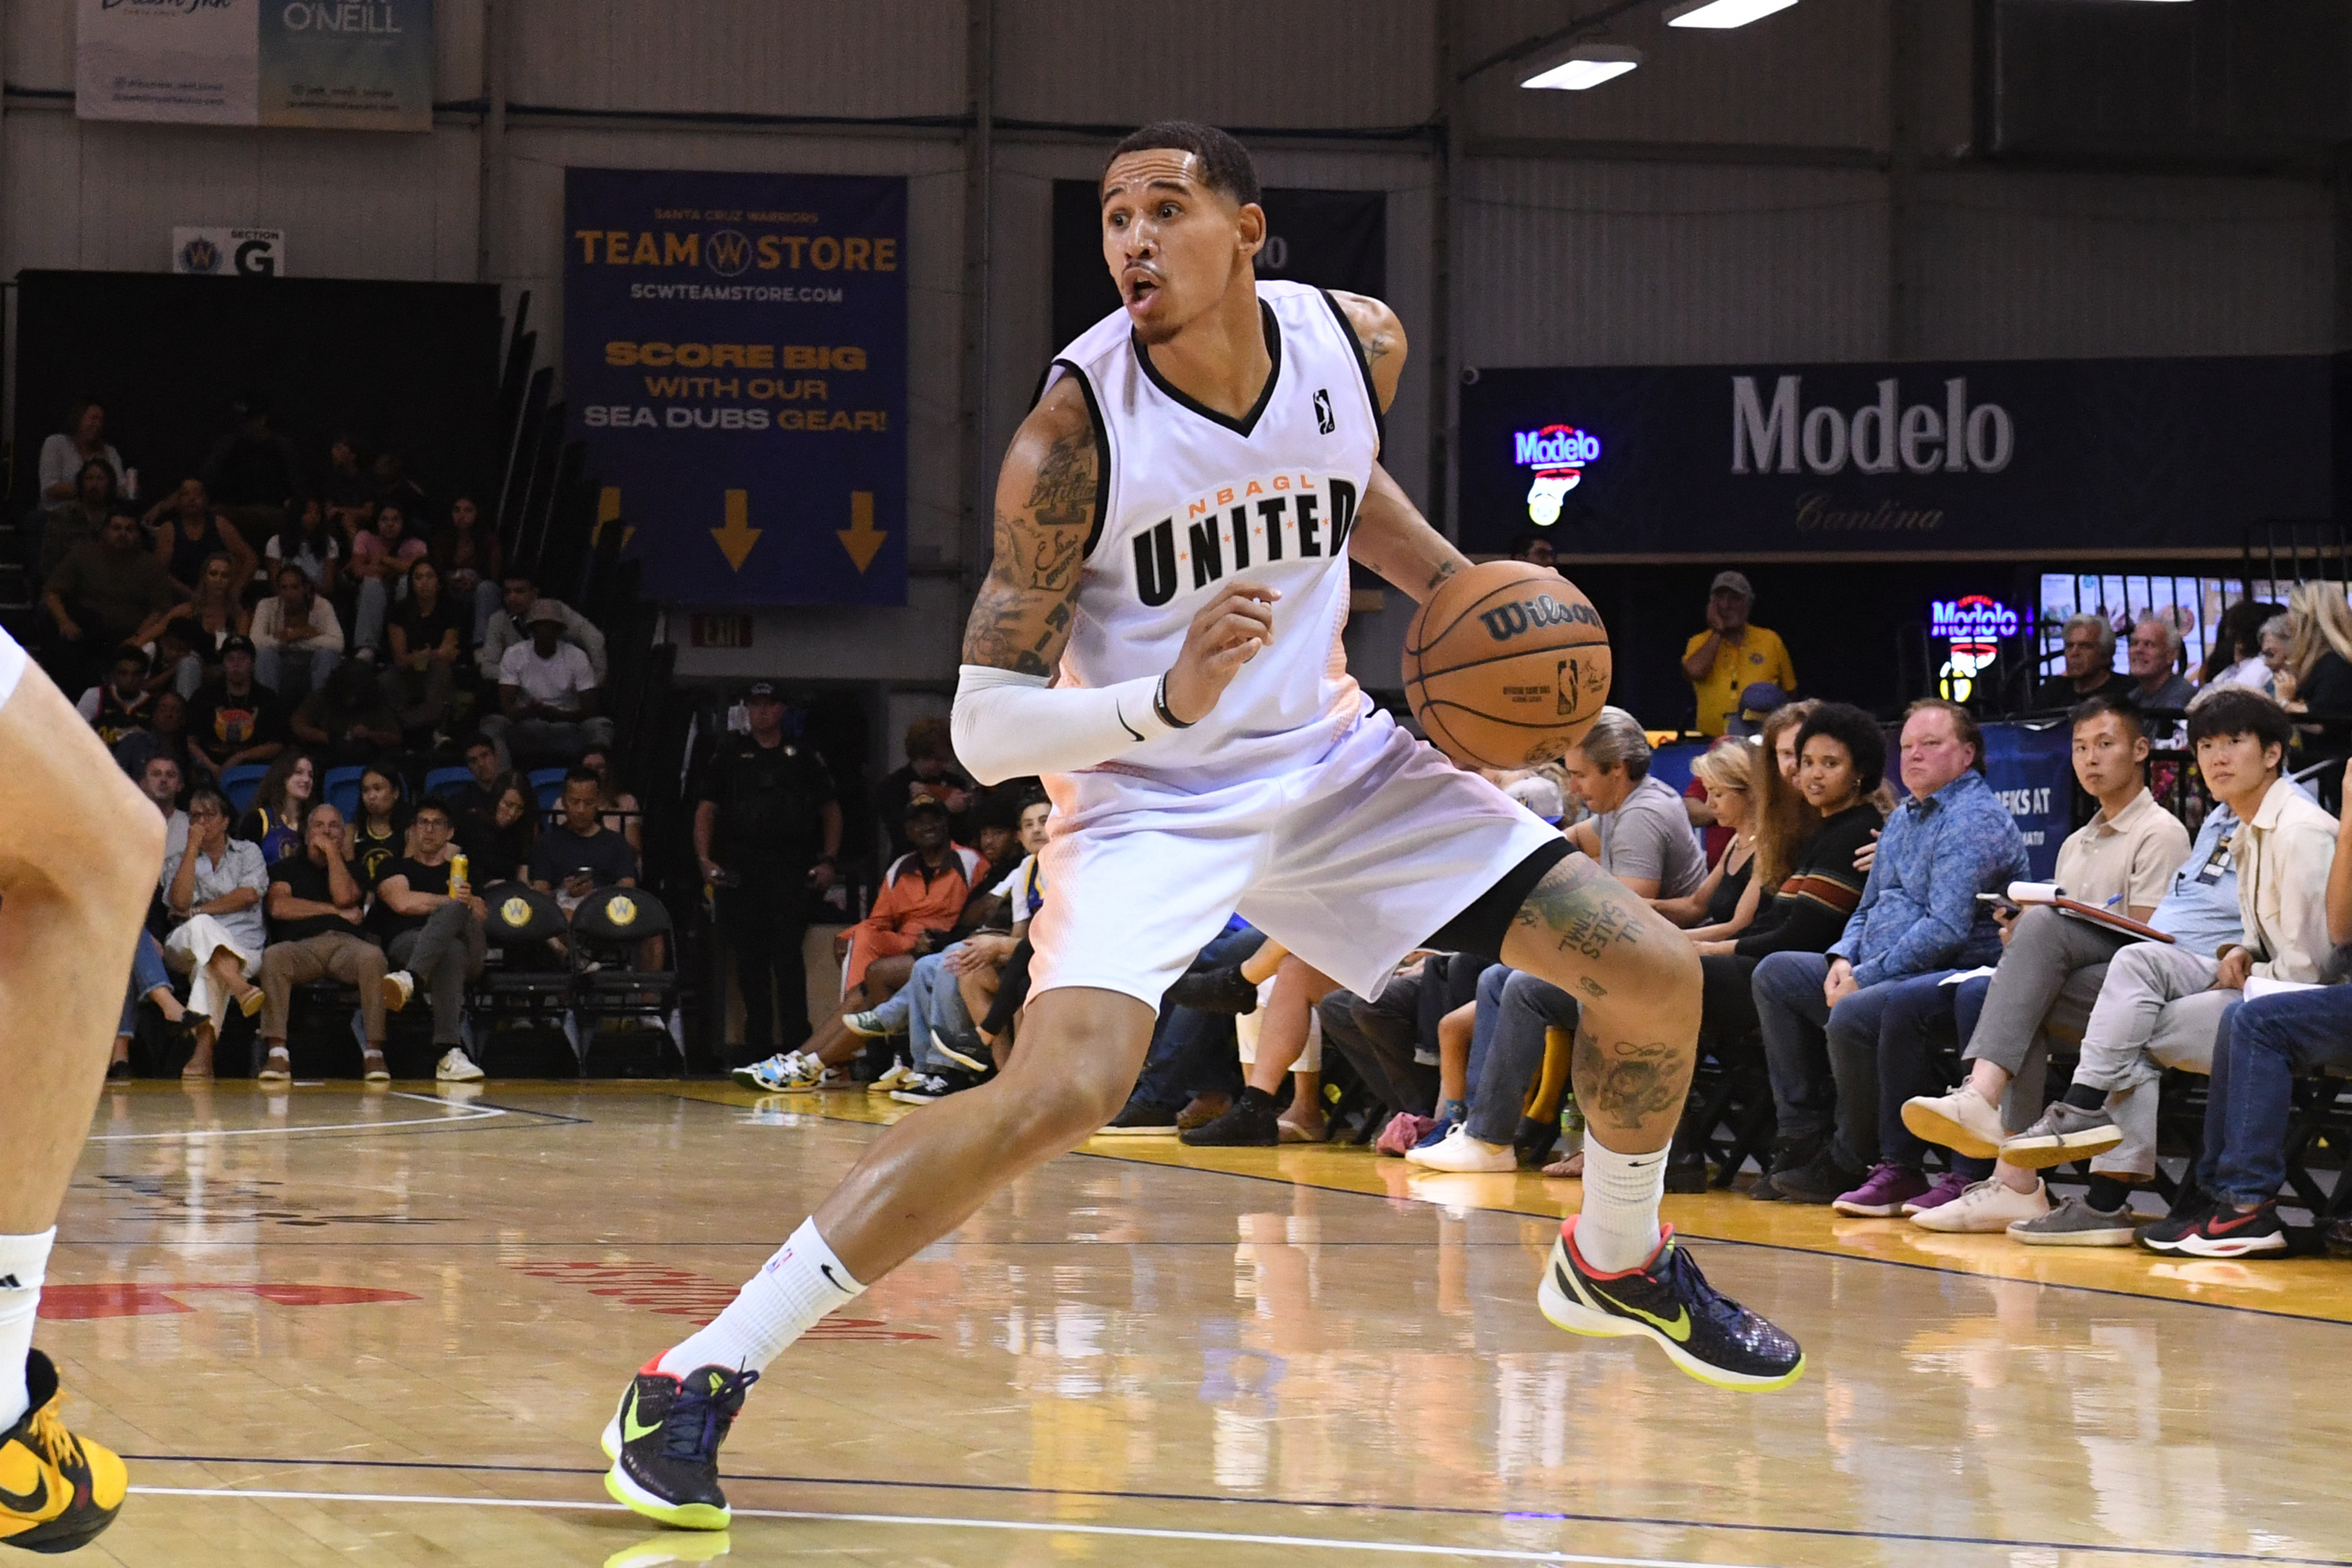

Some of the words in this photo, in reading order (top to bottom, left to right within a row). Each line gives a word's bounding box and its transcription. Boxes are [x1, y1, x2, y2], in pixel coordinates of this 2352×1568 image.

[283, 2, 403, 33] O'NEILL
[655, 209, 699, 221] SANTA
[704, 210, 742, 221] CRUZ
[747, 211, 818, 223] WARRIORS
[231, 230, 279, 240] SECTION
[575, 229, 699, 266] TEAM
[757, 235, 897, 271] STORE
[234, 240, 274, 277] G
[629, 283, 843, 304] SCWTEAMSTORE.COM
[604, 341, 774, 369] SCORE
[784, 344, 867, 371] BIG
[645, 376, 739, 399] WITH
[747, 377, 827, 401] OUR
[584, 405, 659, 427] SEA
[665, 407, 770, 430] DUBS
[777, 409, 887, 431] GEAR!
[1731, 375, 2015, 476] Modelo
[1515, 429, 1600, 464] Modelo
[1795, 489, 1943, 533] Cantina
[1132, 477, 1356, 607] UNITED
[1478, 593, 1605, 641] Wilson
[1932, 601, 2018, 636] Modelo
[2033, 787, 2050, 814] AT
